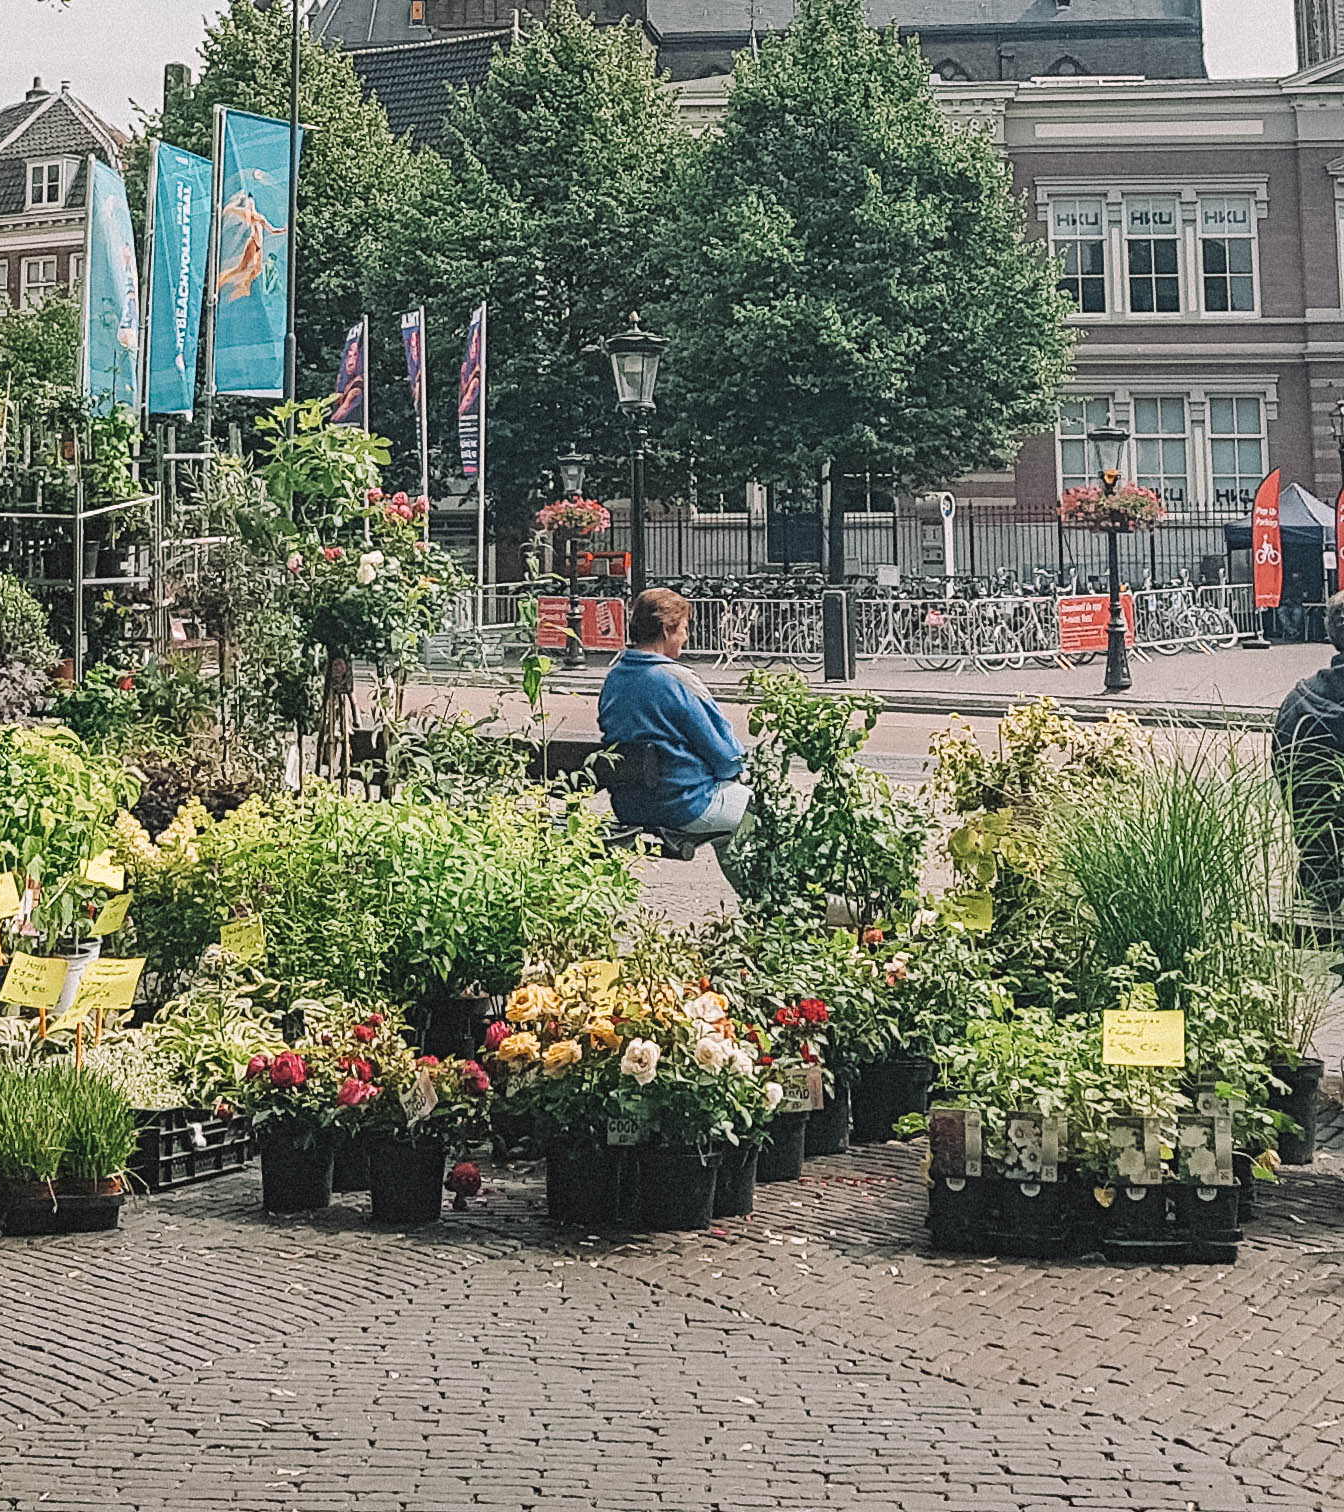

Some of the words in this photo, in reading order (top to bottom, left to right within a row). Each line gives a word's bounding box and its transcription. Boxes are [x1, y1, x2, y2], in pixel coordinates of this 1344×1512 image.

[1057, 212, 1098, 226] HKU
[1131, 211, 1172, 225] HKU
[1205, 210, 1246, 224] HKU
[609, 1119, 640, 1134] GOOD
